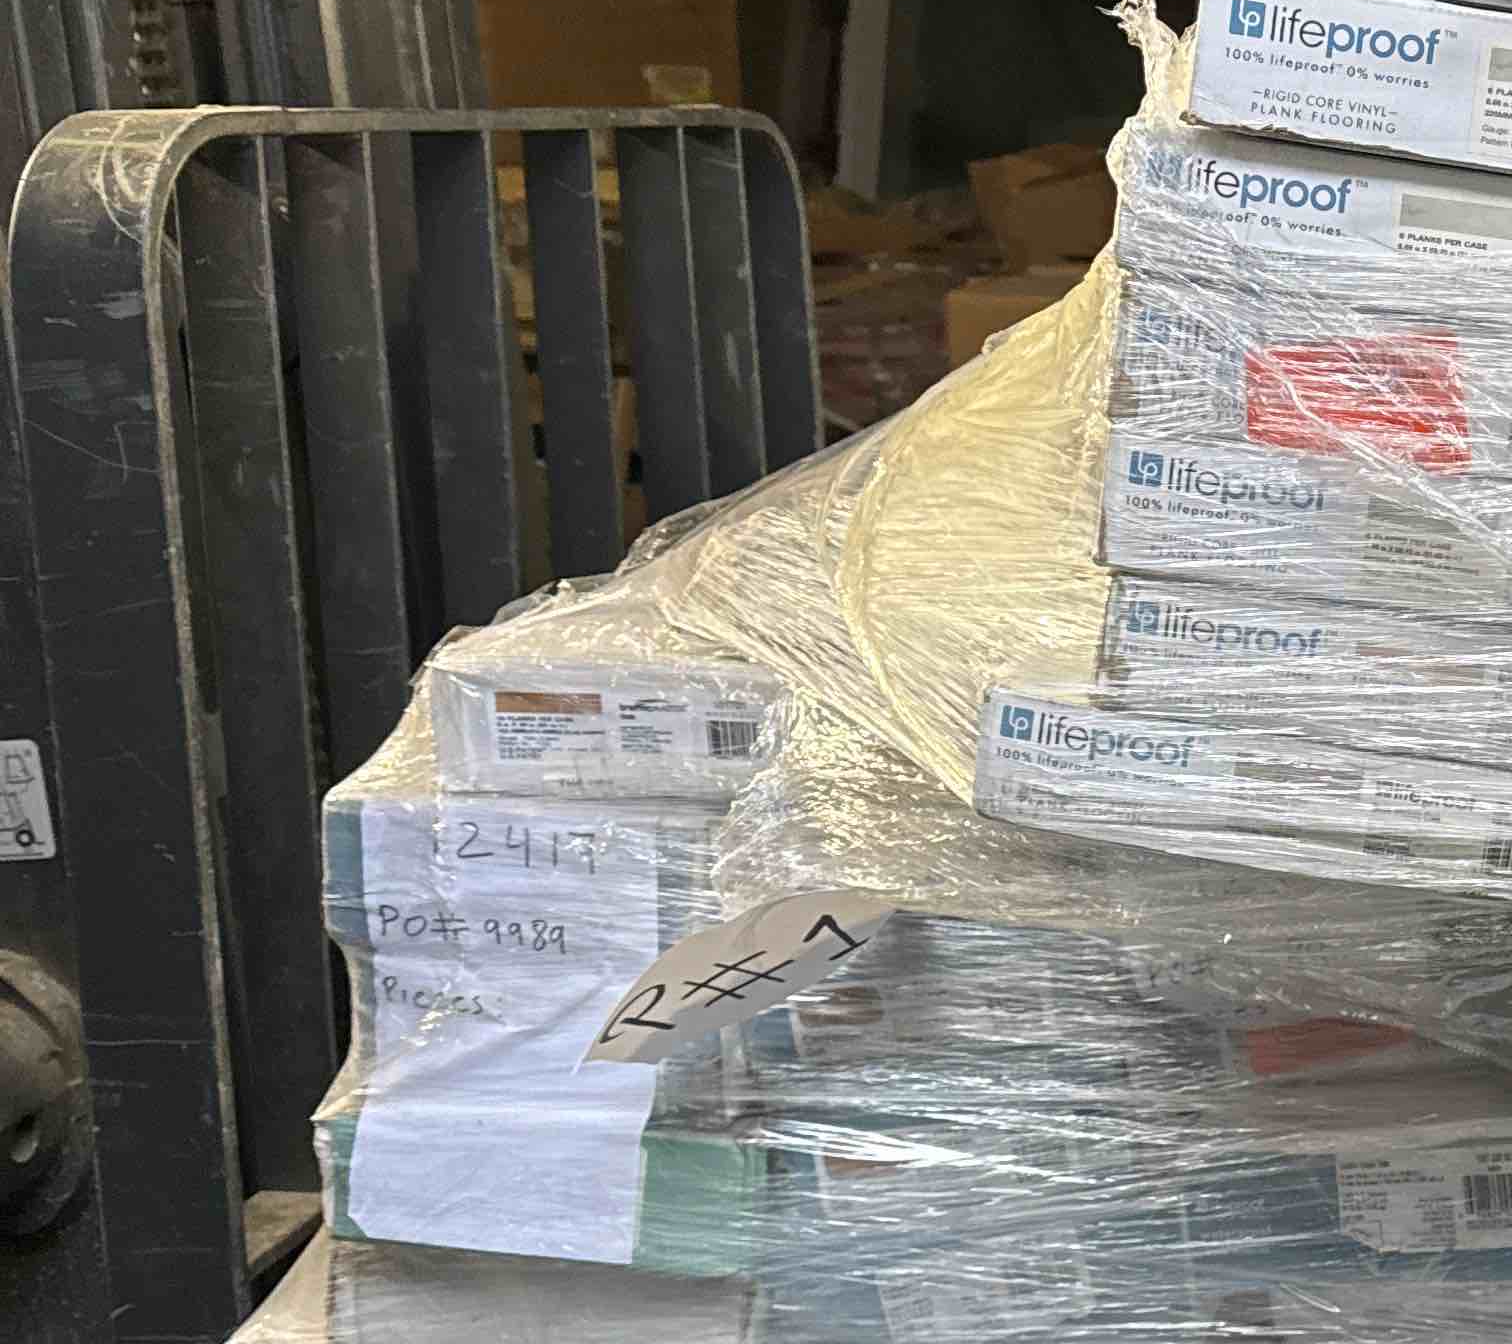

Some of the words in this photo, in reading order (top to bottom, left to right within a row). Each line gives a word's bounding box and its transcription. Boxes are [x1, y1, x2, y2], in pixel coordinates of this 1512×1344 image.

[1270, 5, 1441, 64] lifeproof
[1225, 47, 1264, 64] 100%
[1270, 55, 1335, 75] lifeproof
[1346, 65, 1369, 80] 0%
[1374, 72, 1430, 89] worries
[1250, 102, 1303, 121] PLANK
[1311, 111, 1397, 134] FLOORING
[1306, 95, 1343, 111] CORE
[1260, 214, 1282, 228] 0%
[1287, 221, 1342, 237] worries
[1037, 712, 1195, 768] lifeproof
